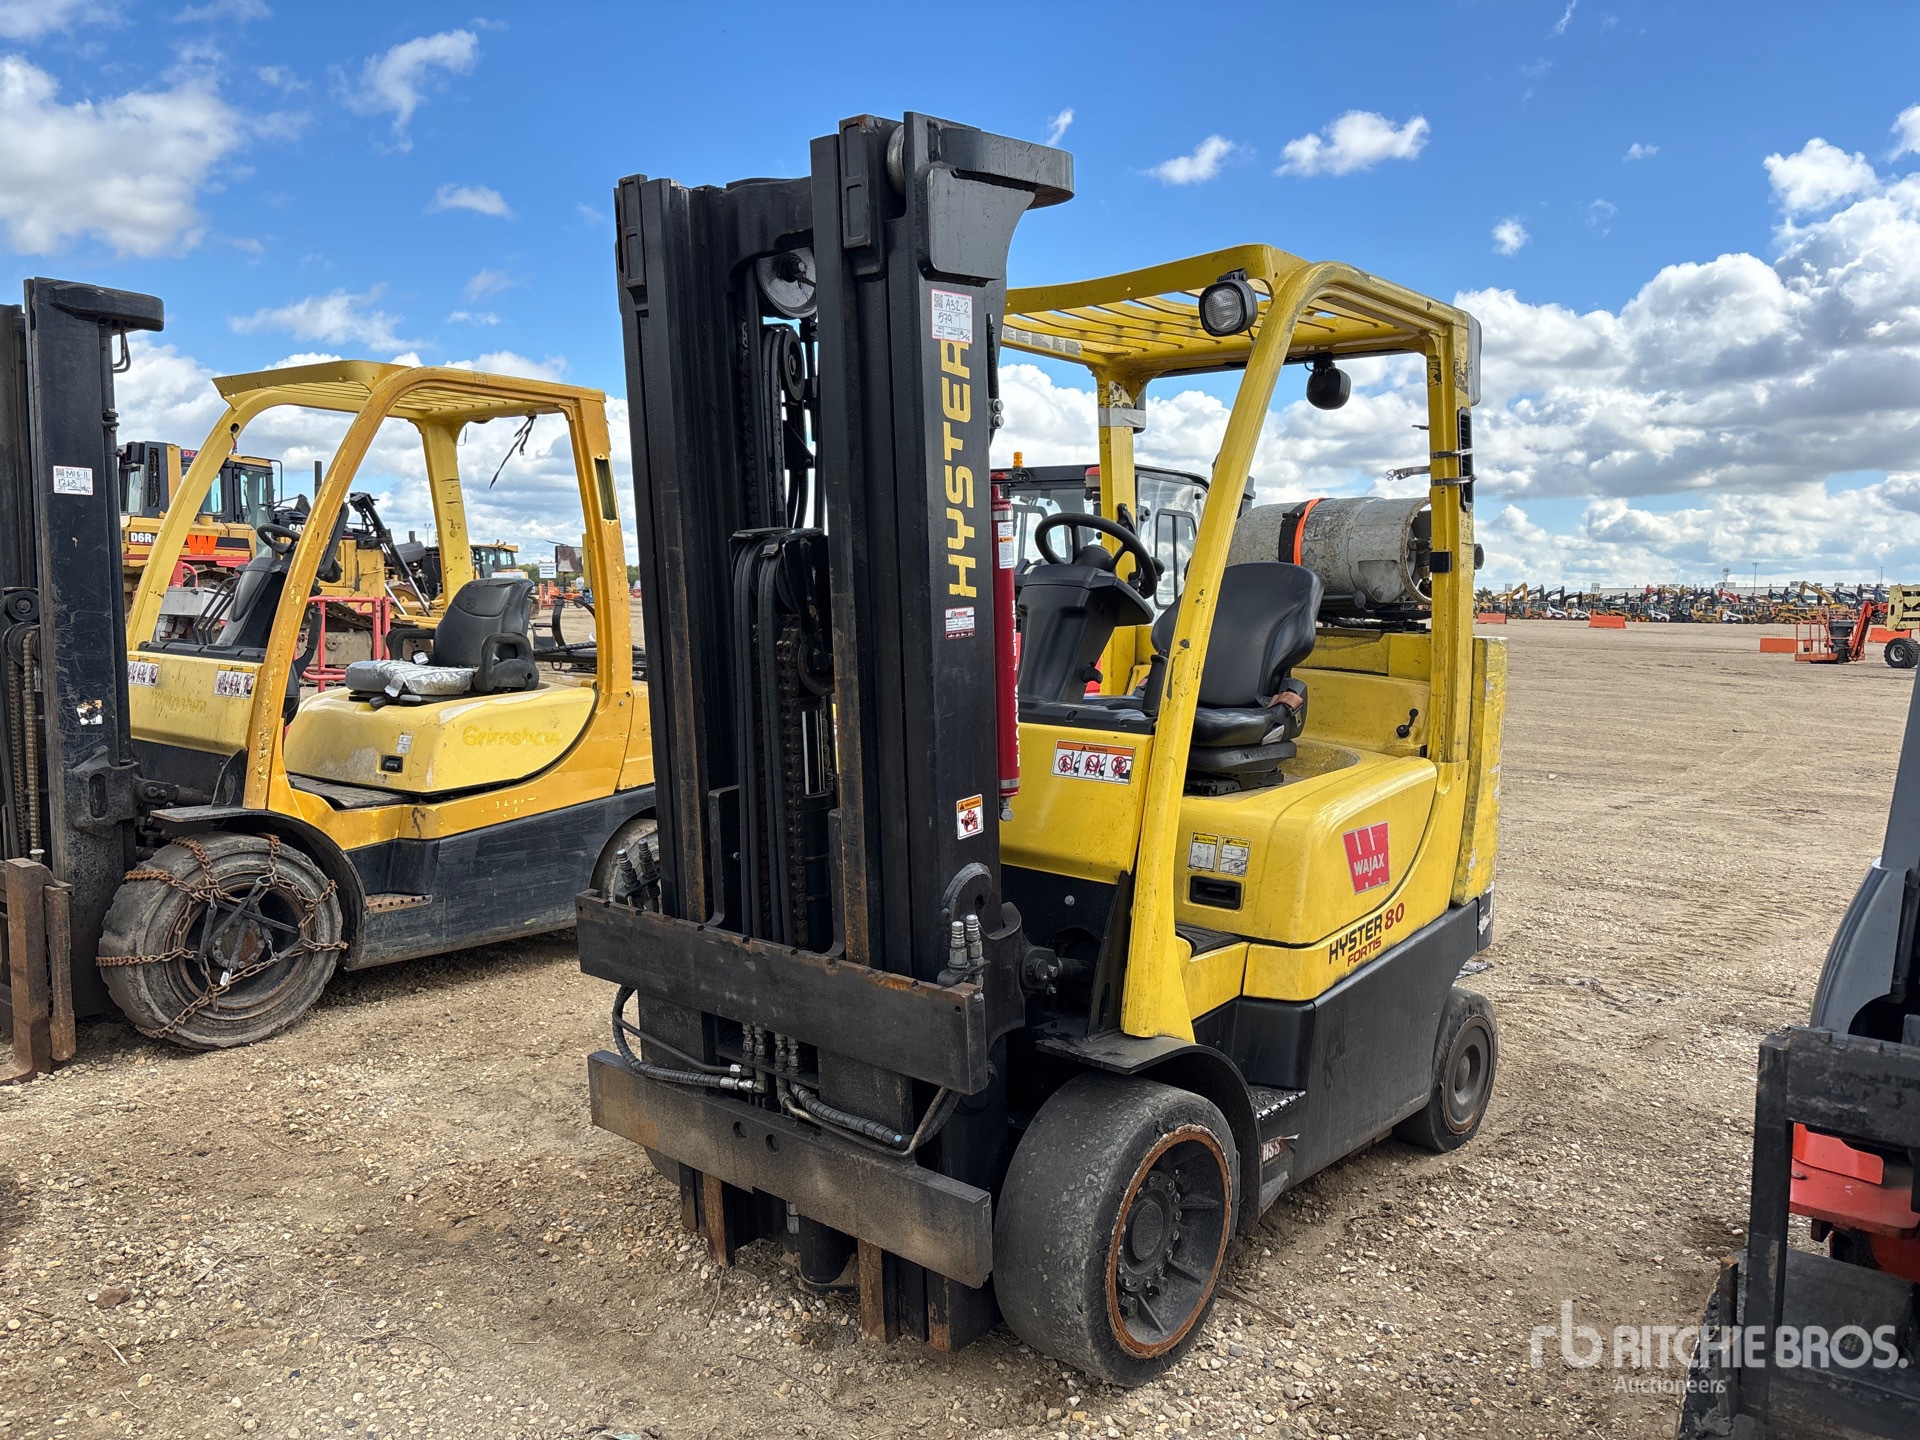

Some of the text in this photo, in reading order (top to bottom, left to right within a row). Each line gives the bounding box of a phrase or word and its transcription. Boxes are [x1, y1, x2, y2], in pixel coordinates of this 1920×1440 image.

[940, 340, 977, 598] HYSTER
[462, 726, 562, 747] Grimshaw
[1088, 746, 1109, 754] WARNING
[1353, 853, 1385, 877] WAJAX
[1328, 902, 1405, 965] HYSTER 80
[1347, 935, 1382, 967] FORTIS
